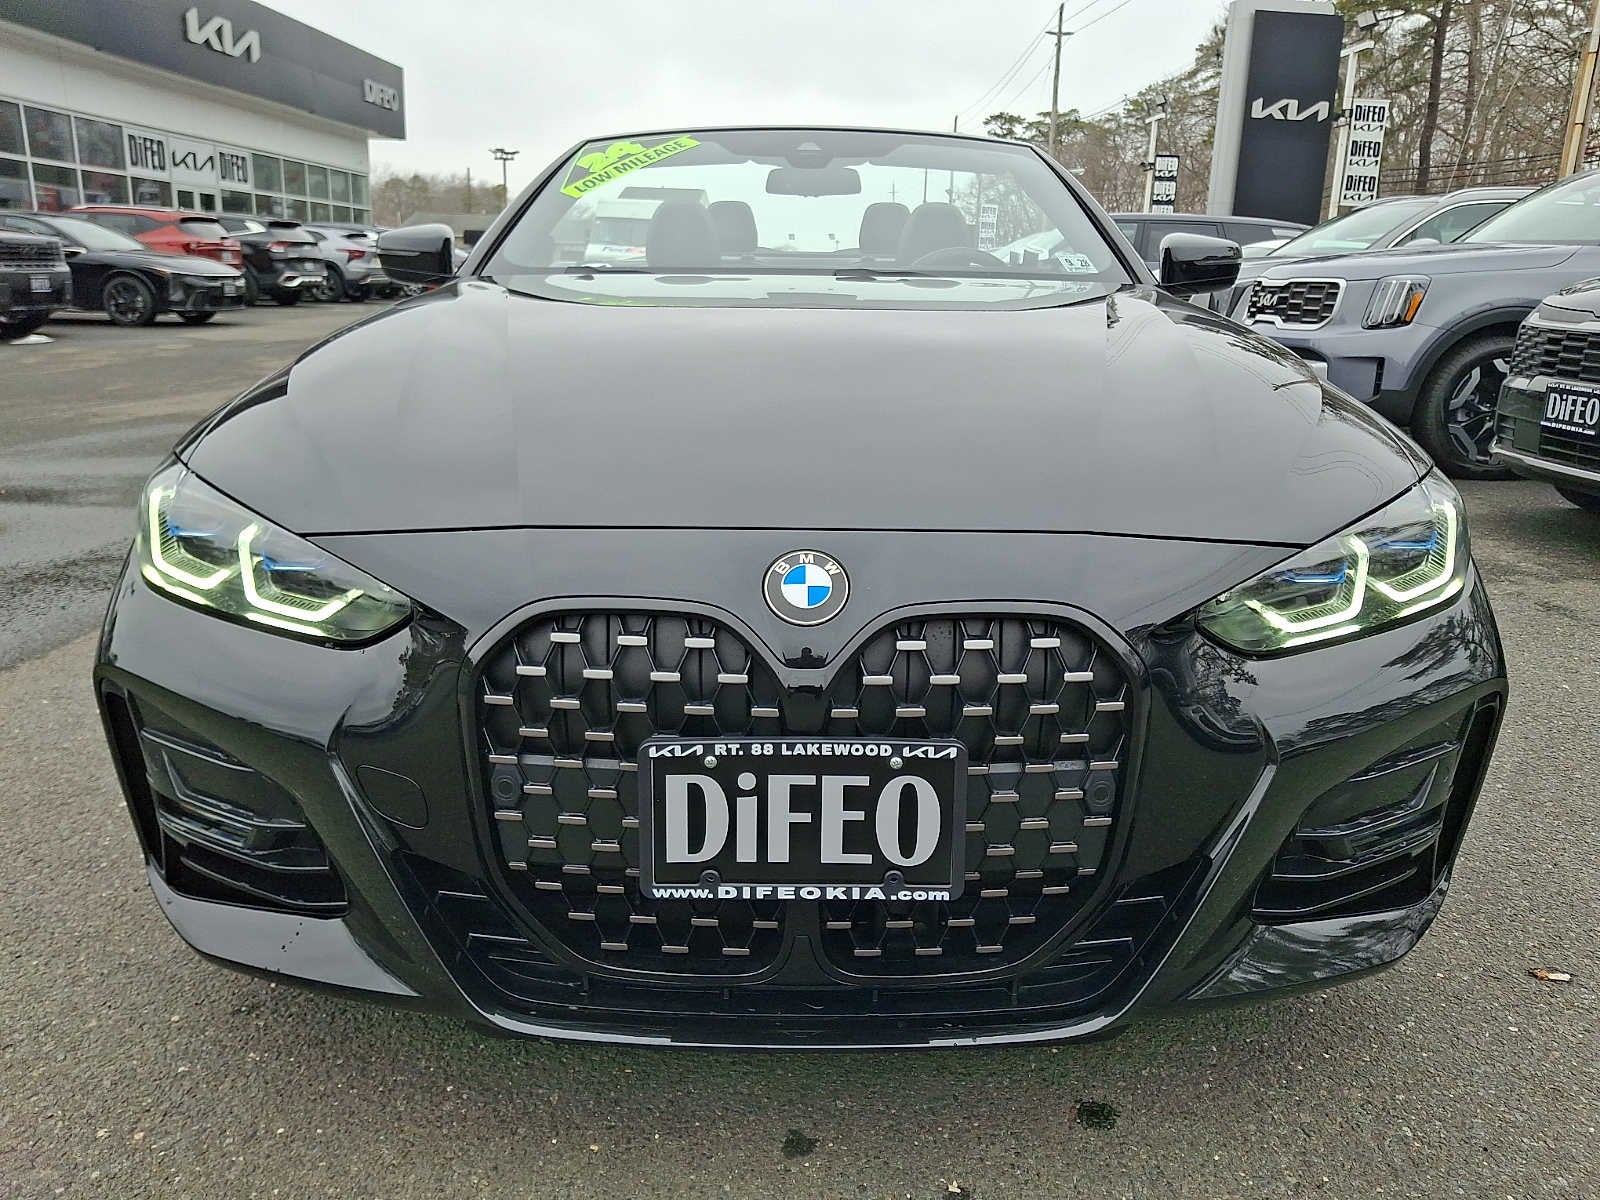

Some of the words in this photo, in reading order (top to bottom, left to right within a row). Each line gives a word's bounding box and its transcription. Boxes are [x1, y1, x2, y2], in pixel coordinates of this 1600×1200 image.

[1251, 96, 1330, 122] KIA
[1354, 104, 1386, 122] DiFEO
[128, 134, 166, 171] DiFEO
[1350, 139, 1381, 158] DiFEO
[574, 170, 612, 193] LOW
[614, 141, 687, 174] MILEAGE
[1345, 175, 1377, 192] DiFEO
[1546, 393, 1600, 425] DiFEO
[774, 552, 841, 576] BMW
[714, 743, 744, 756] RT.
[751, 743, 774, 756] 88
[781, 743, 893, 757] LAKEWOOD
[665, 772, 941, 867] DiFEO
[652, 886, 950, 902] www.DIFEOKIA.com
